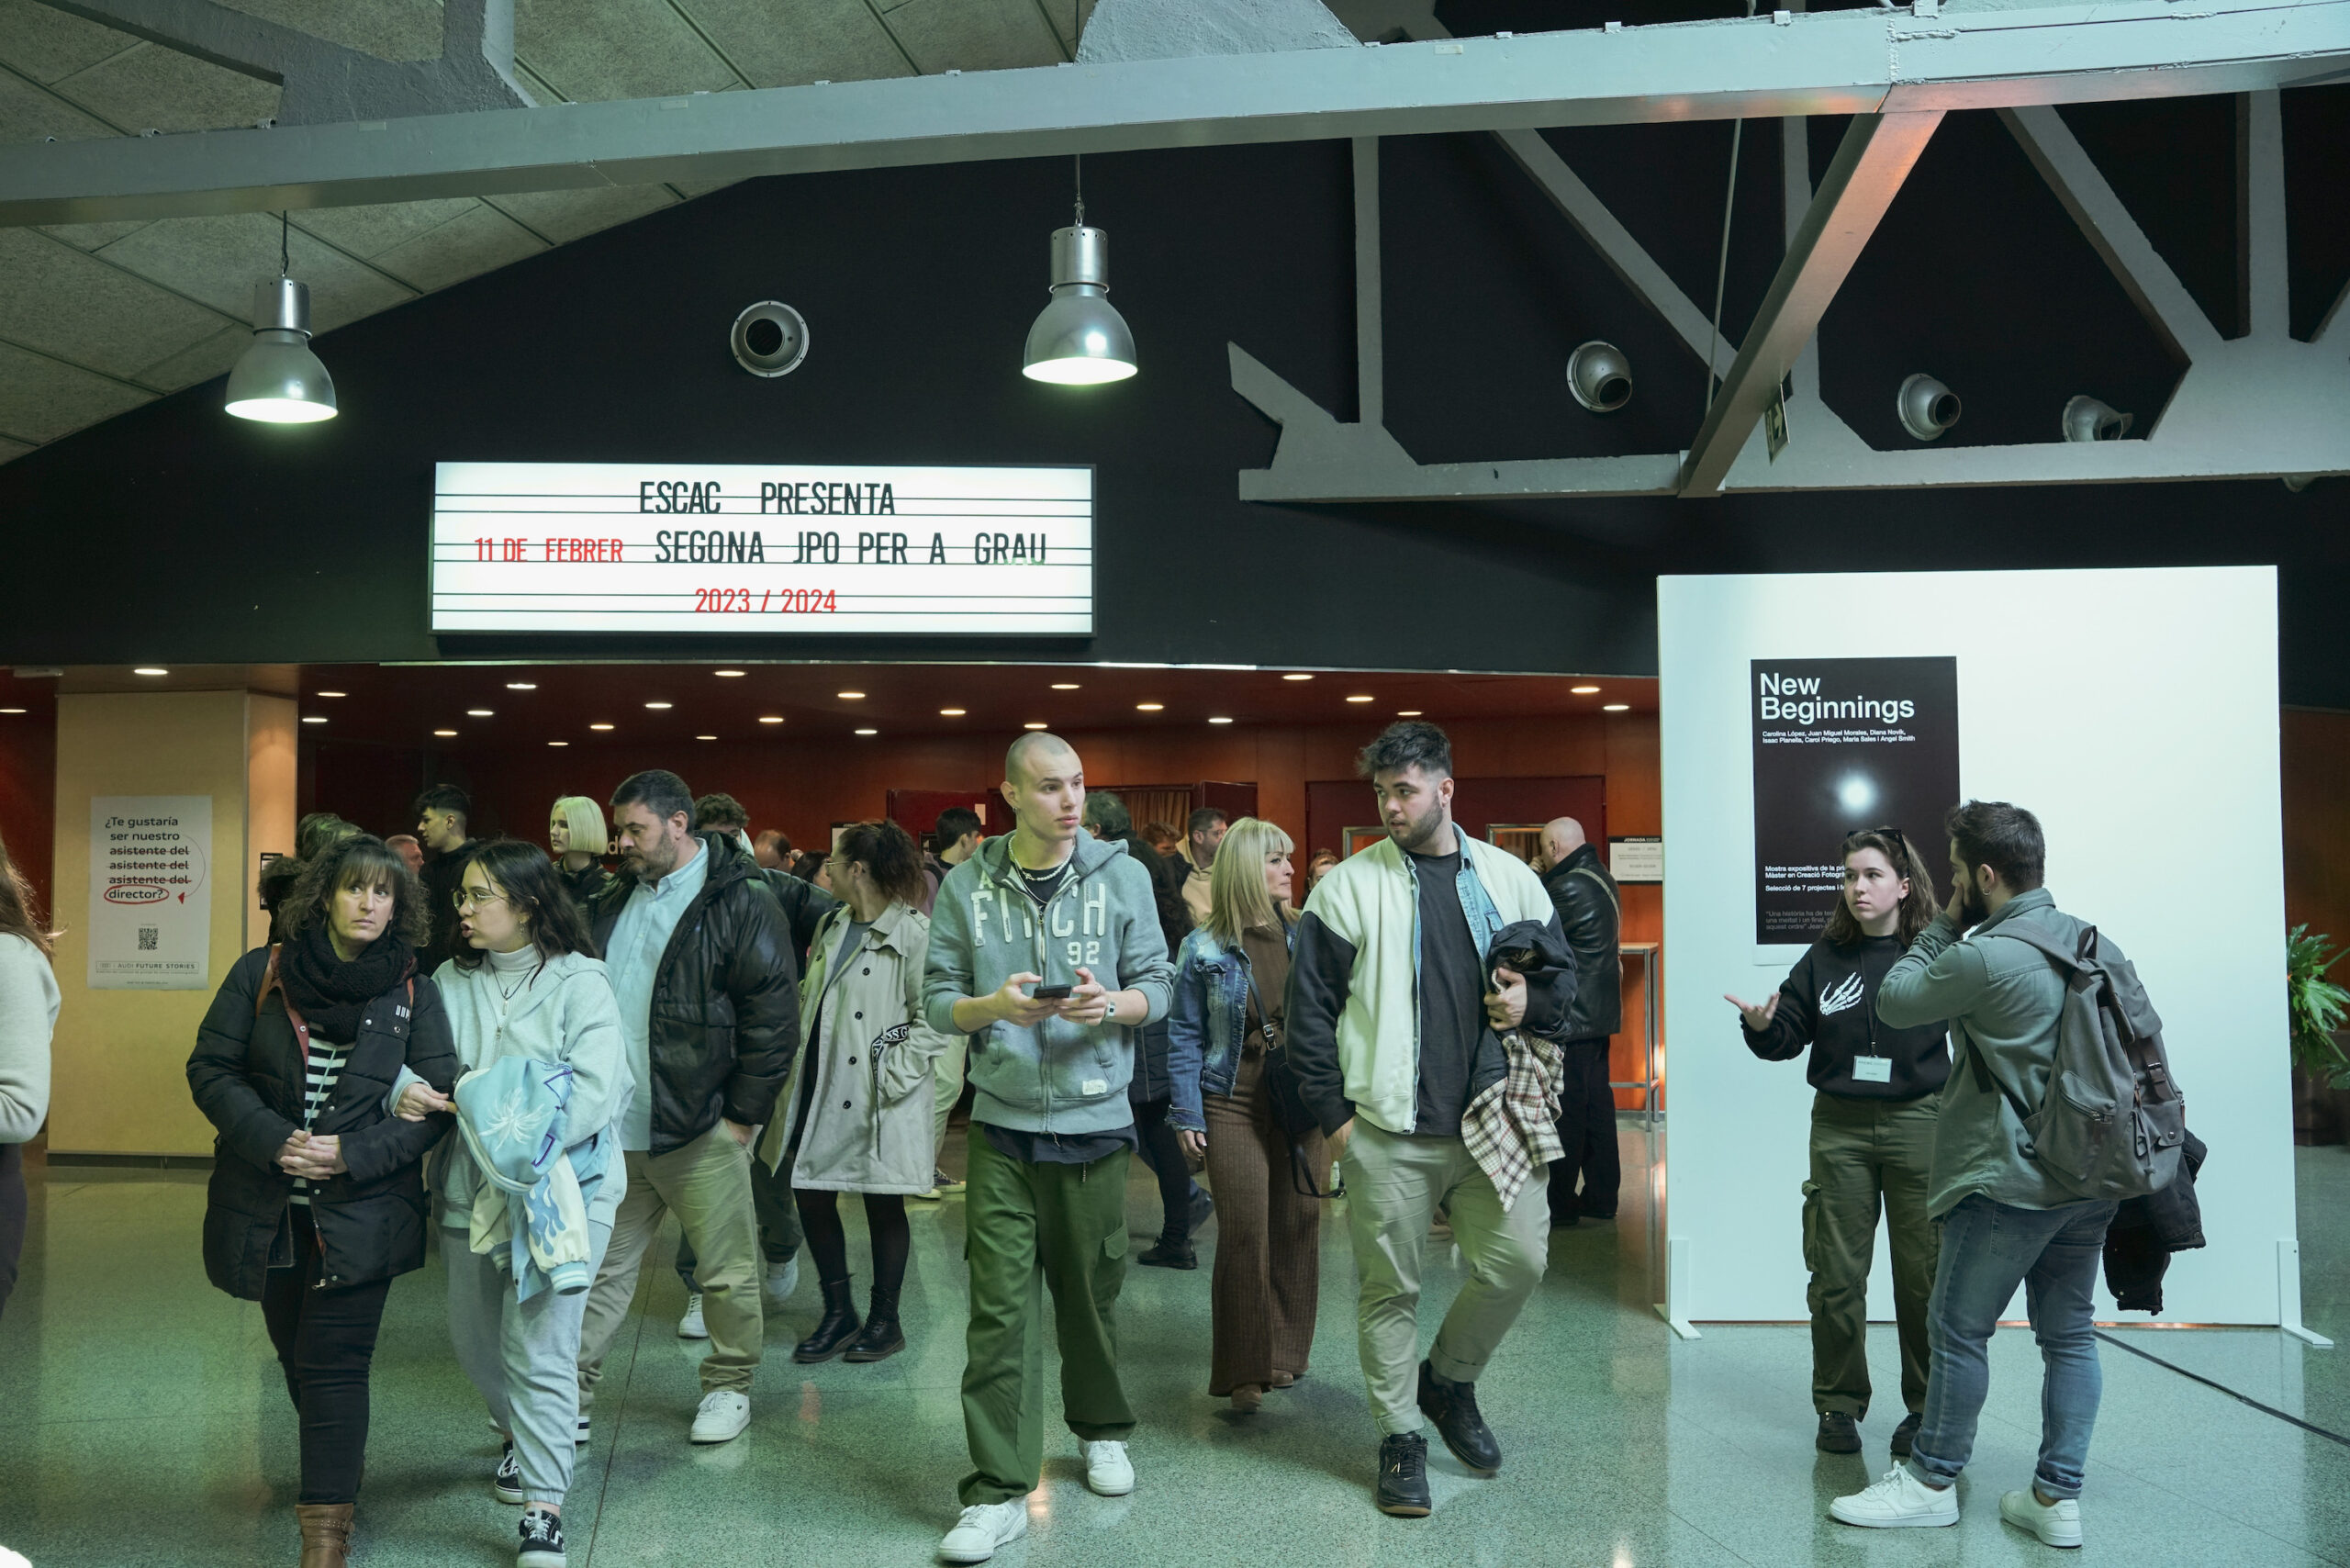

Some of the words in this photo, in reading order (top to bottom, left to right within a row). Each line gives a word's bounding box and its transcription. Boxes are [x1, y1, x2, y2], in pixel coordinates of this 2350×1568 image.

[639, 480, 721, 514] ESCAC
[760, 482, 896, 515] PRESENTA
[474, 537, 494, 563] 11
[503, 538, 528, 563] DE
[545, 538, 624, 563] FEBRER
[655, 530, 766, 564] SEGONA
[792, 532, 841, 564] JPO
[858, 532, 908, 564] PER
[929, 532, 946, 564] A
[975, 532, 1047, 566] GRAU
[695, 588, 751, 613] 2023
[760, 589, 771, 613] /
[780, 588, 837, 614] 2024
[1760, 672, 1821, 696] New
[1761, 695, 1915, 725] Beginnings
[1823, 729, 1842, 737] Miguel
[105, 816, 125, 828] ¿Te
[128, 816, 178, 829] gustaría
[110, 833, 129, 841] ser
[132, 832, 180, 841] nuestro
[109, 846, 166, 855] asistente
[170, 846, 189, 855] del
[109, 860, 166, 869] asistente
[170, 860, 189, 869] del
[108, 875, 166, 884] asistente
[169, 875, 189, 884] del
[1807, 884, 1836, 892] projectes
[108, 889, 163, 899] director?
[1067, 941, 1100, 965] 92
